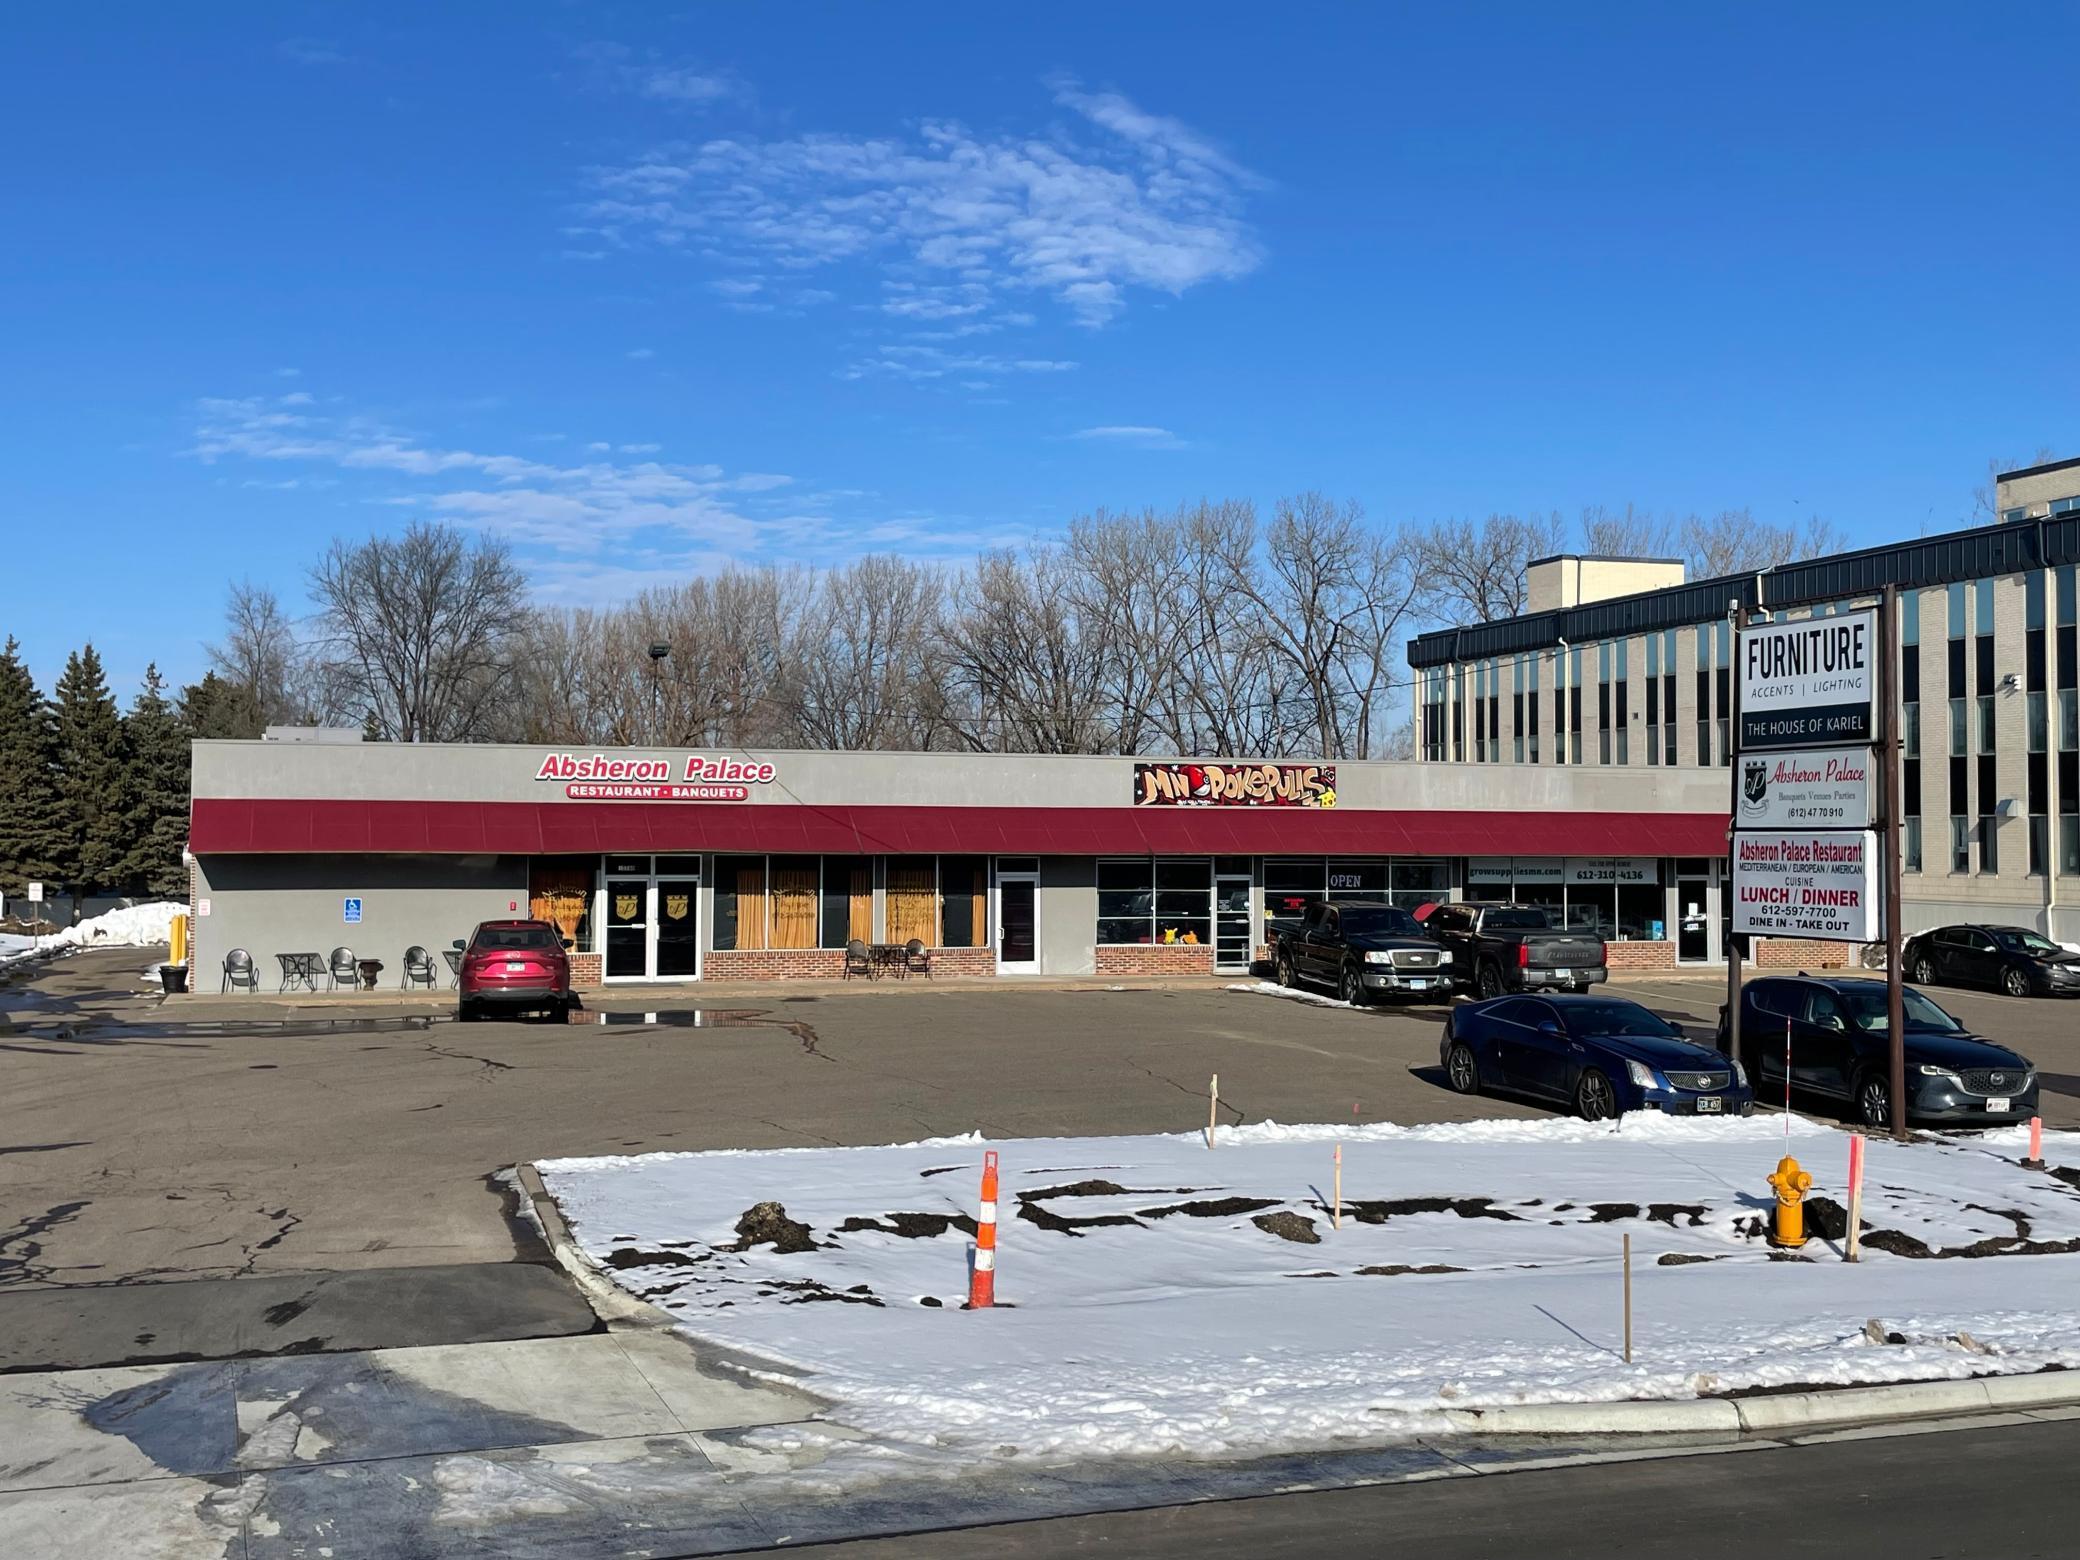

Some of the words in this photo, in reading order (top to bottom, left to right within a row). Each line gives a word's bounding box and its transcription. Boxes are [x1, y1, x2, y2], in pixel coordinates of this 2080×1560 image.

[1748, 623, 1865, 681] FURNITURE
[1751, 684, 1795, 699] ACCENTS
[1813, 677, 1862, 693] LIGHTING
[1747, 722, 1767, 736] THE
[1770, 719, 1806, 735] HOUSE
[1808, 718, 1823, 733] OF
[1826, 715, 1864, 731] KARIEL
[536, 754, 670, 781] Absheron
[684, 756, 776, 783] Palace
[1767, 759, 1822, 785] Absheron
[1825, 756, 1865, 783] Palace
[570, 786, 660, 797] RESTAURANT
[672, 787, 744, 798] BANQUETS
[1139, 768, 1190, 806] MN
[1778, 791, 1806, 803] Banquets
[1808, 791, 1832, 800] Venues
[1834, 790, 1856, 800] Parties
[1788, 808, 1807, 819] (612)
[1739, 839, 1779, 861] Absheron
[1781, 840, 1811, 862] Palace
[1812, 840, 1863, 863] Restaurant
[1739, 862, 1788, 873] MEDITERRANEAN
[1793, 863, 1825, 874] EUROPEAN
[1831, 864, 1863, 874] AMERICAN
[1330, 874, 1362, 888] OPEN
[1785, 877, 1814, 887] CUISINE
[1741, 886, 1790, 904] LUNCH
[1802, 889, 1860, 907] DINNER
[1761, 905, 1837, 918] 612-597-7700
[1749, 916, 1773, 927] DINE
[1776, 918, 1787, 928] IN
[1795, 919, 1823, 930] TAKE
[1825, 921, 1850, 931] OUT
